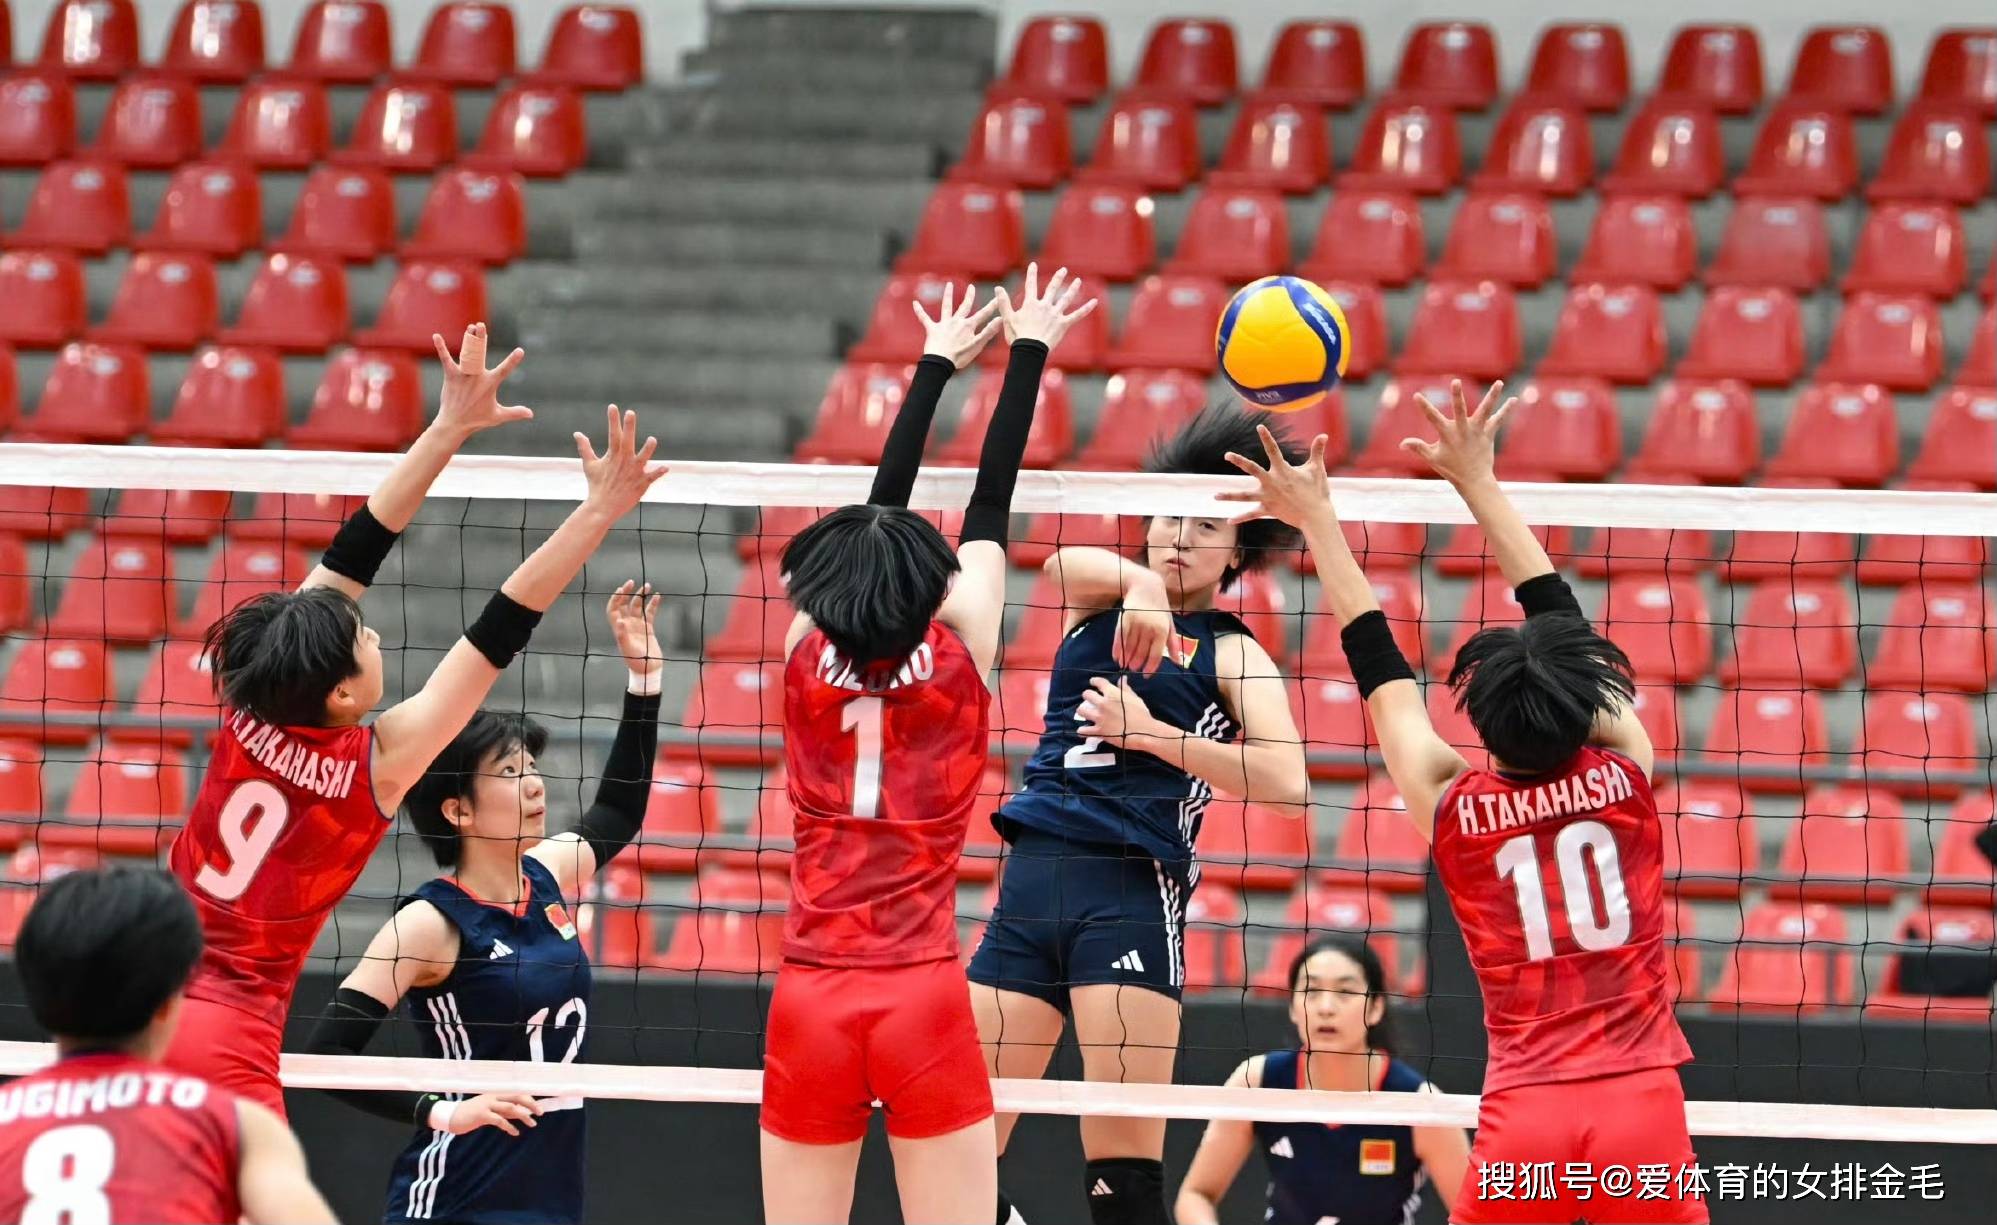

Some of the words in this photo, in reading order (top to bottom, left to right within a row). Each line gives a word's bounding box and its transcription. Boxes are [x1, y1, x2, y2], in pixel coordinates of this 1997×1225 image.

[840, 695, 885, 819] 1
[1457, 760, 1633, 836] H.TAKAHASHI
[193, 778, 290, 900] 9
[1494, 820, 1632, 962] 10
[525, 996, 588, 1113] 12
[19, 1122, 116, 1225] 8
